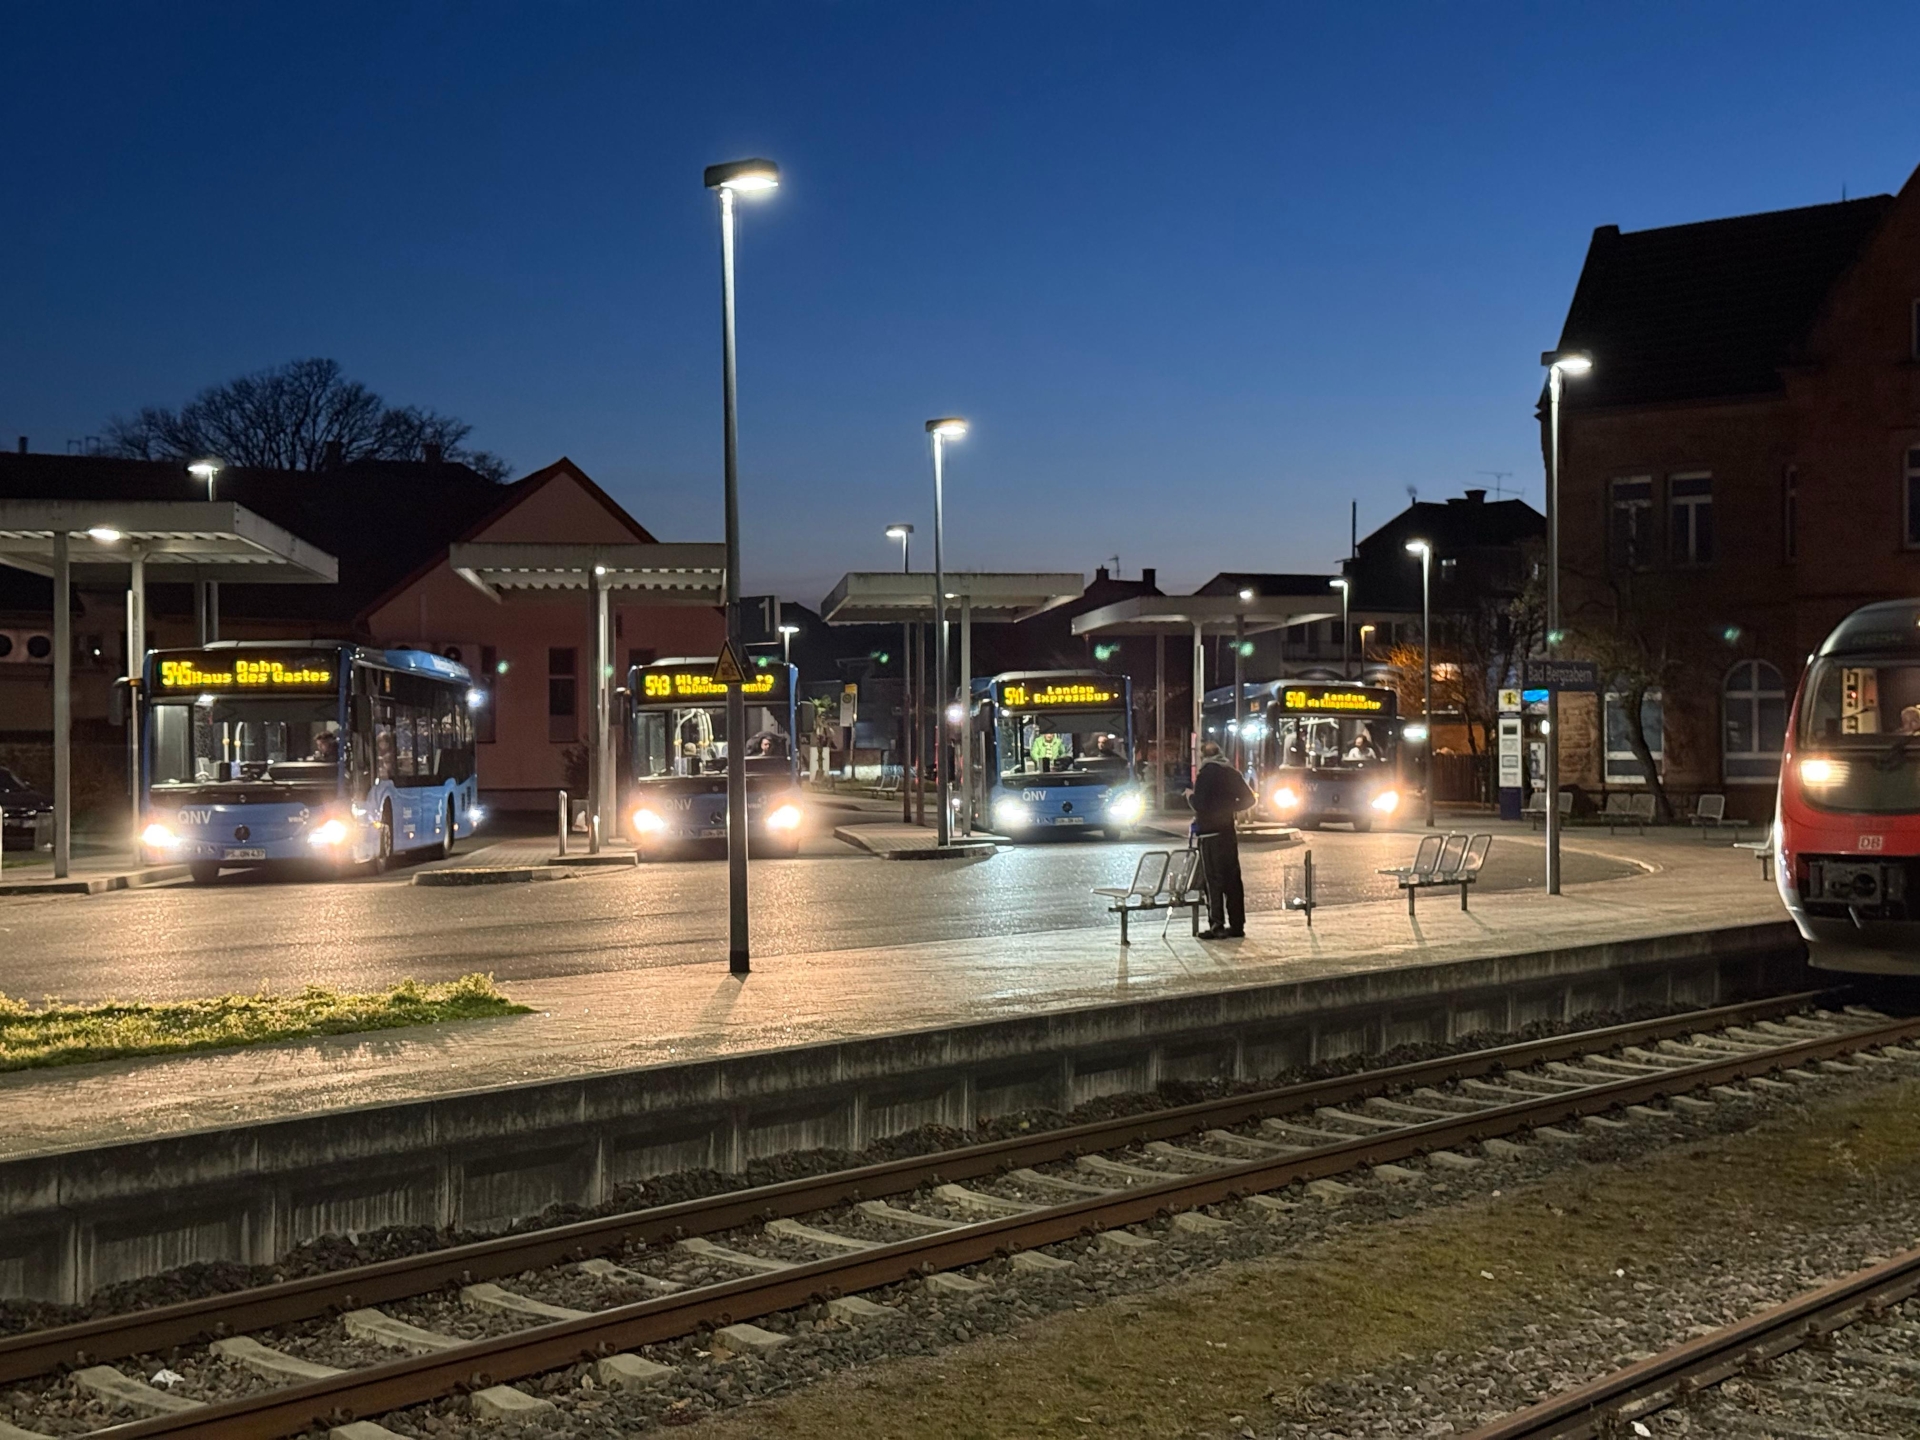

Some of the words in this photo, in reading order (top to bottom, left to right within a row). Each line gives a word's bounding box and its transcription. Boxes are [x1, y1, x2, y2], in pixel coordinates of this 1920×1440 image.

[161, 661, 192, 685] 545
[236, 661, 283, 673] Dahn
[192, 671, 232, 684] Haus
[236, 671, 268, 683] des
[272, 670, 330, 683] Gastes
[1528, 665, 1544, 681] Bad
[1546, 665, 1592, 686] Bergzabern
[645, 674, 671, 696] 543
[1047, 685, 1094, 695] Landau
[1004, 687, 1025, 705] 541
[1033, 692, 1109, 704] Expressbus
[1285, 691, 1306, 708] 540
[1324, 692, 1366, 702] Landau
[1022, 790, 1046, 801] QNV
[664, 798, 692, 811] QNV
[177, 810, 212, 825] QNV
[1860, 836, 1881, 849] DB
